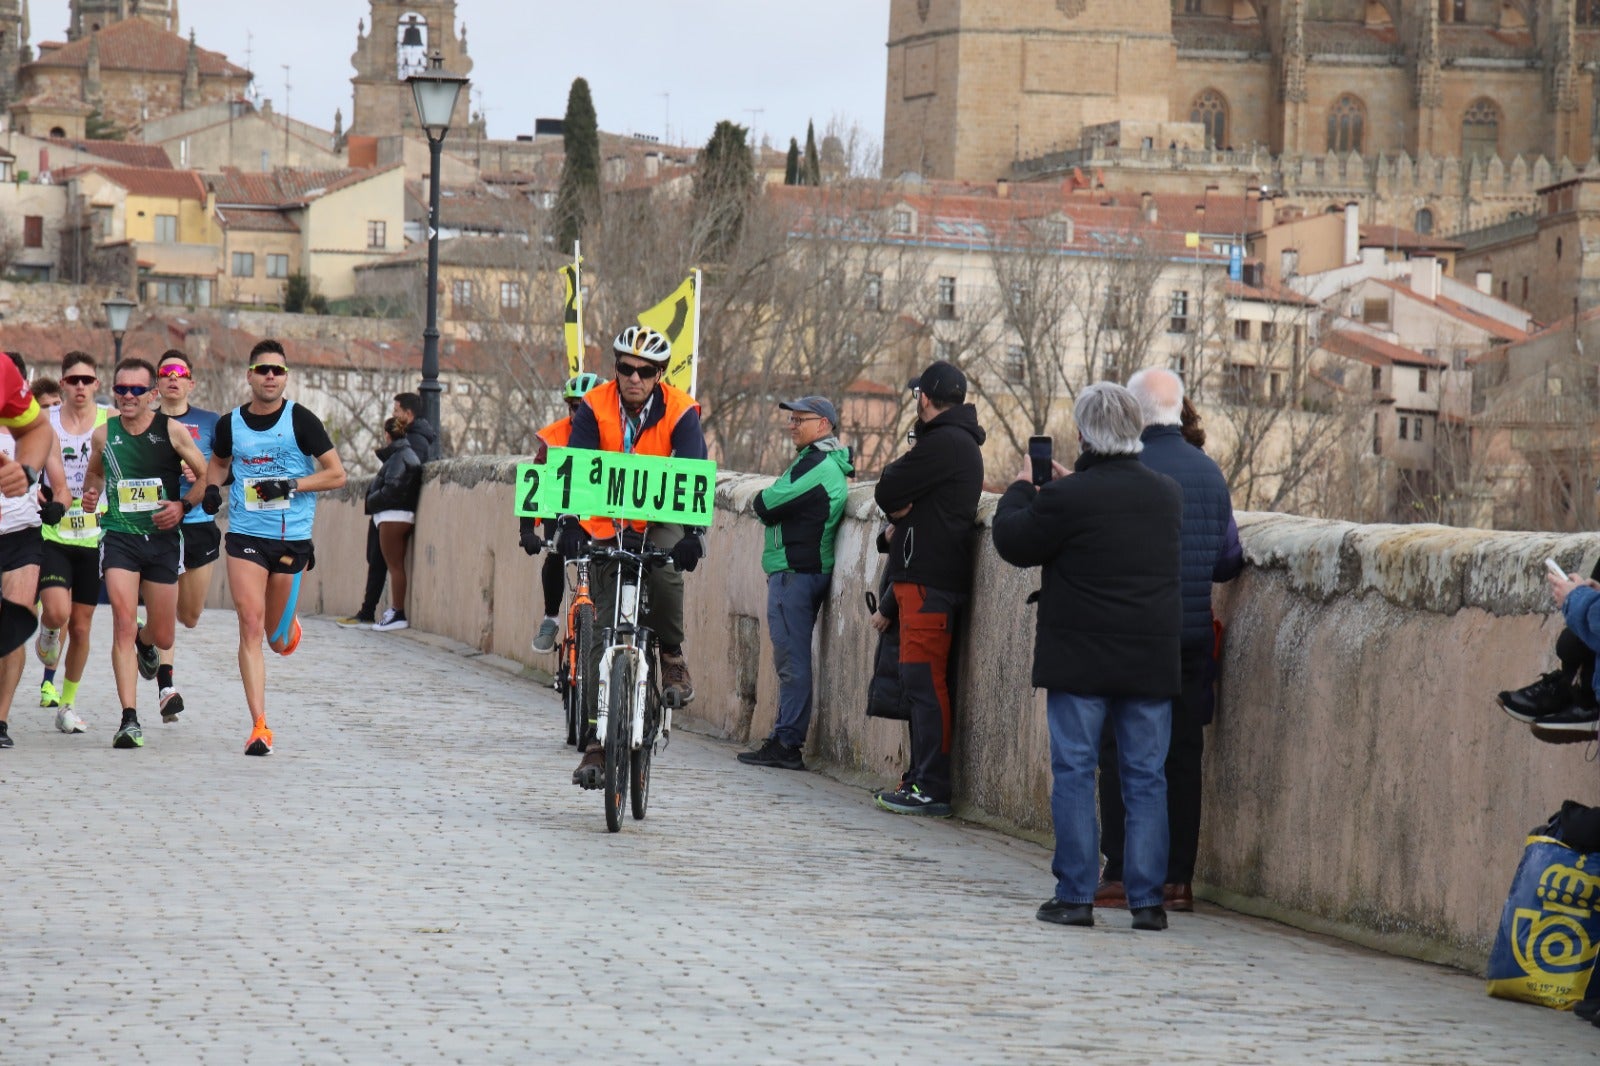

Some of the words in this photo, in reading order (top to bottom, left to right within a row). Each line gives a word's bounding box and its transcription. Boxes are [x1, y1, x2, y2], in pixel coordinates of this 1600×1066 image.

[130, 487, 146, 501] 24
[522, 469, 539, 512] 2
[607, 467, 707, 513] MUJER
[71, 516, 85, 528] 69
